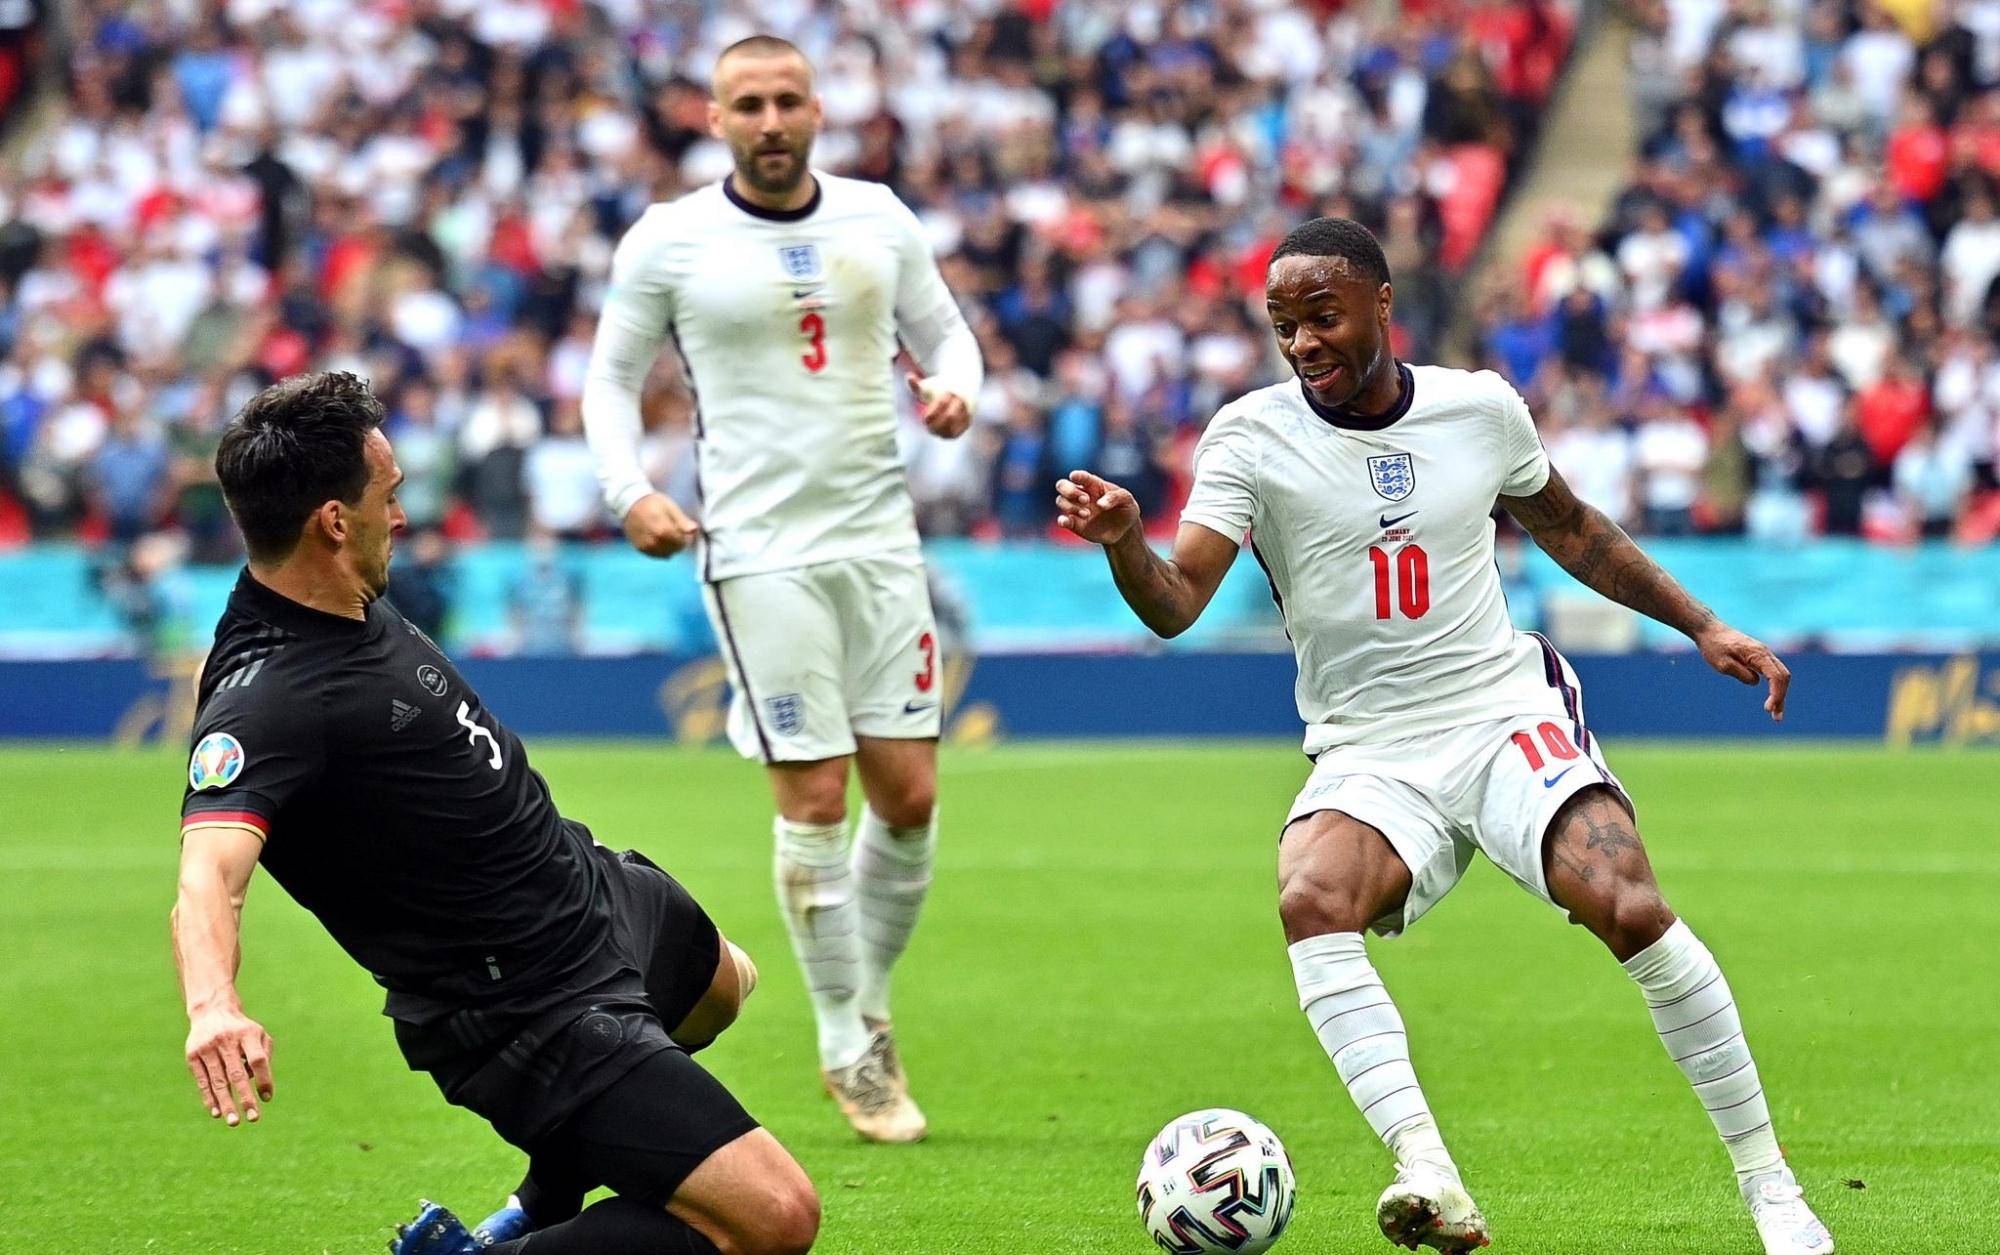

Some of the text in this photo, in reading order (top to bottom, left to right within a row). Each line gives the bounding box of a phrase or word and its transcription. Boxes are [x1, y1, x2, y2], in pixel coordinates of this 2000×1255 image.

[800, 313, 827, 373] 3
[1369, 544, 1430, 620] 10
[915, 632, 934, 692] 3
[456, 700, 503, 770] 5
[1510, 721, 1580, 772] 10
